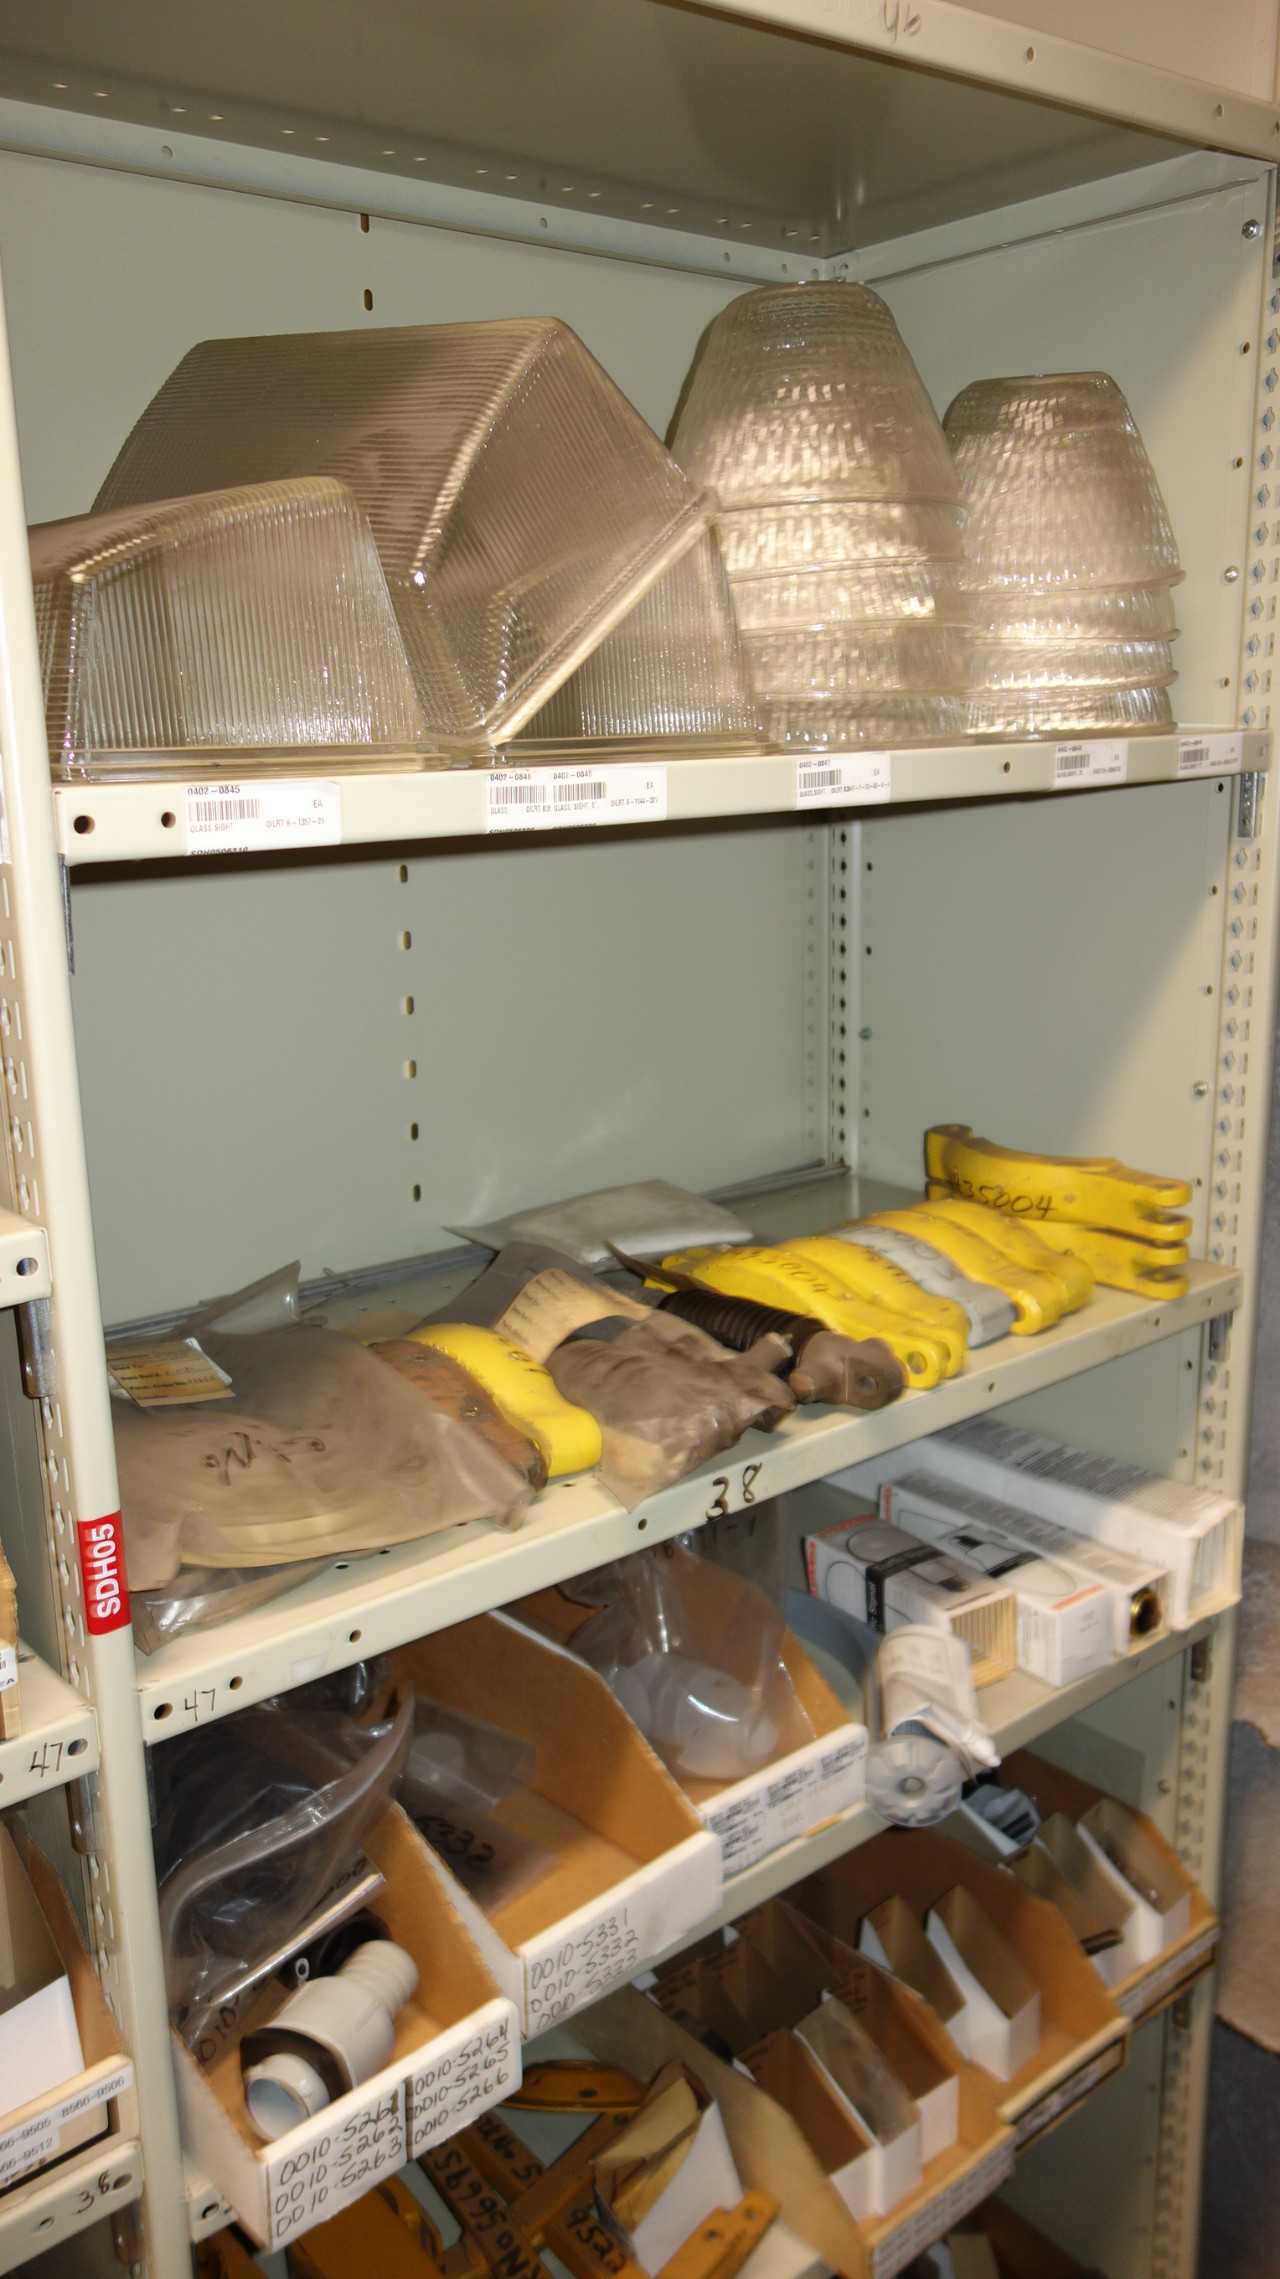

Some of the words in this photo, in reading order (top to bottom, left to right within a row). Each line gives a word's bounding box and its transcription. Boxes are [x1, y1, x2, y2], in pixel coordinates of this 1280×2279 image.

[705, 1463, 763, 1520] 38
[91, 1523, 121, 1618] SDH05
[184, 1687, 216, 1722] 47
[29, 1741, 64, 1778] 47
[73, 2169, 111, 2215] 38
